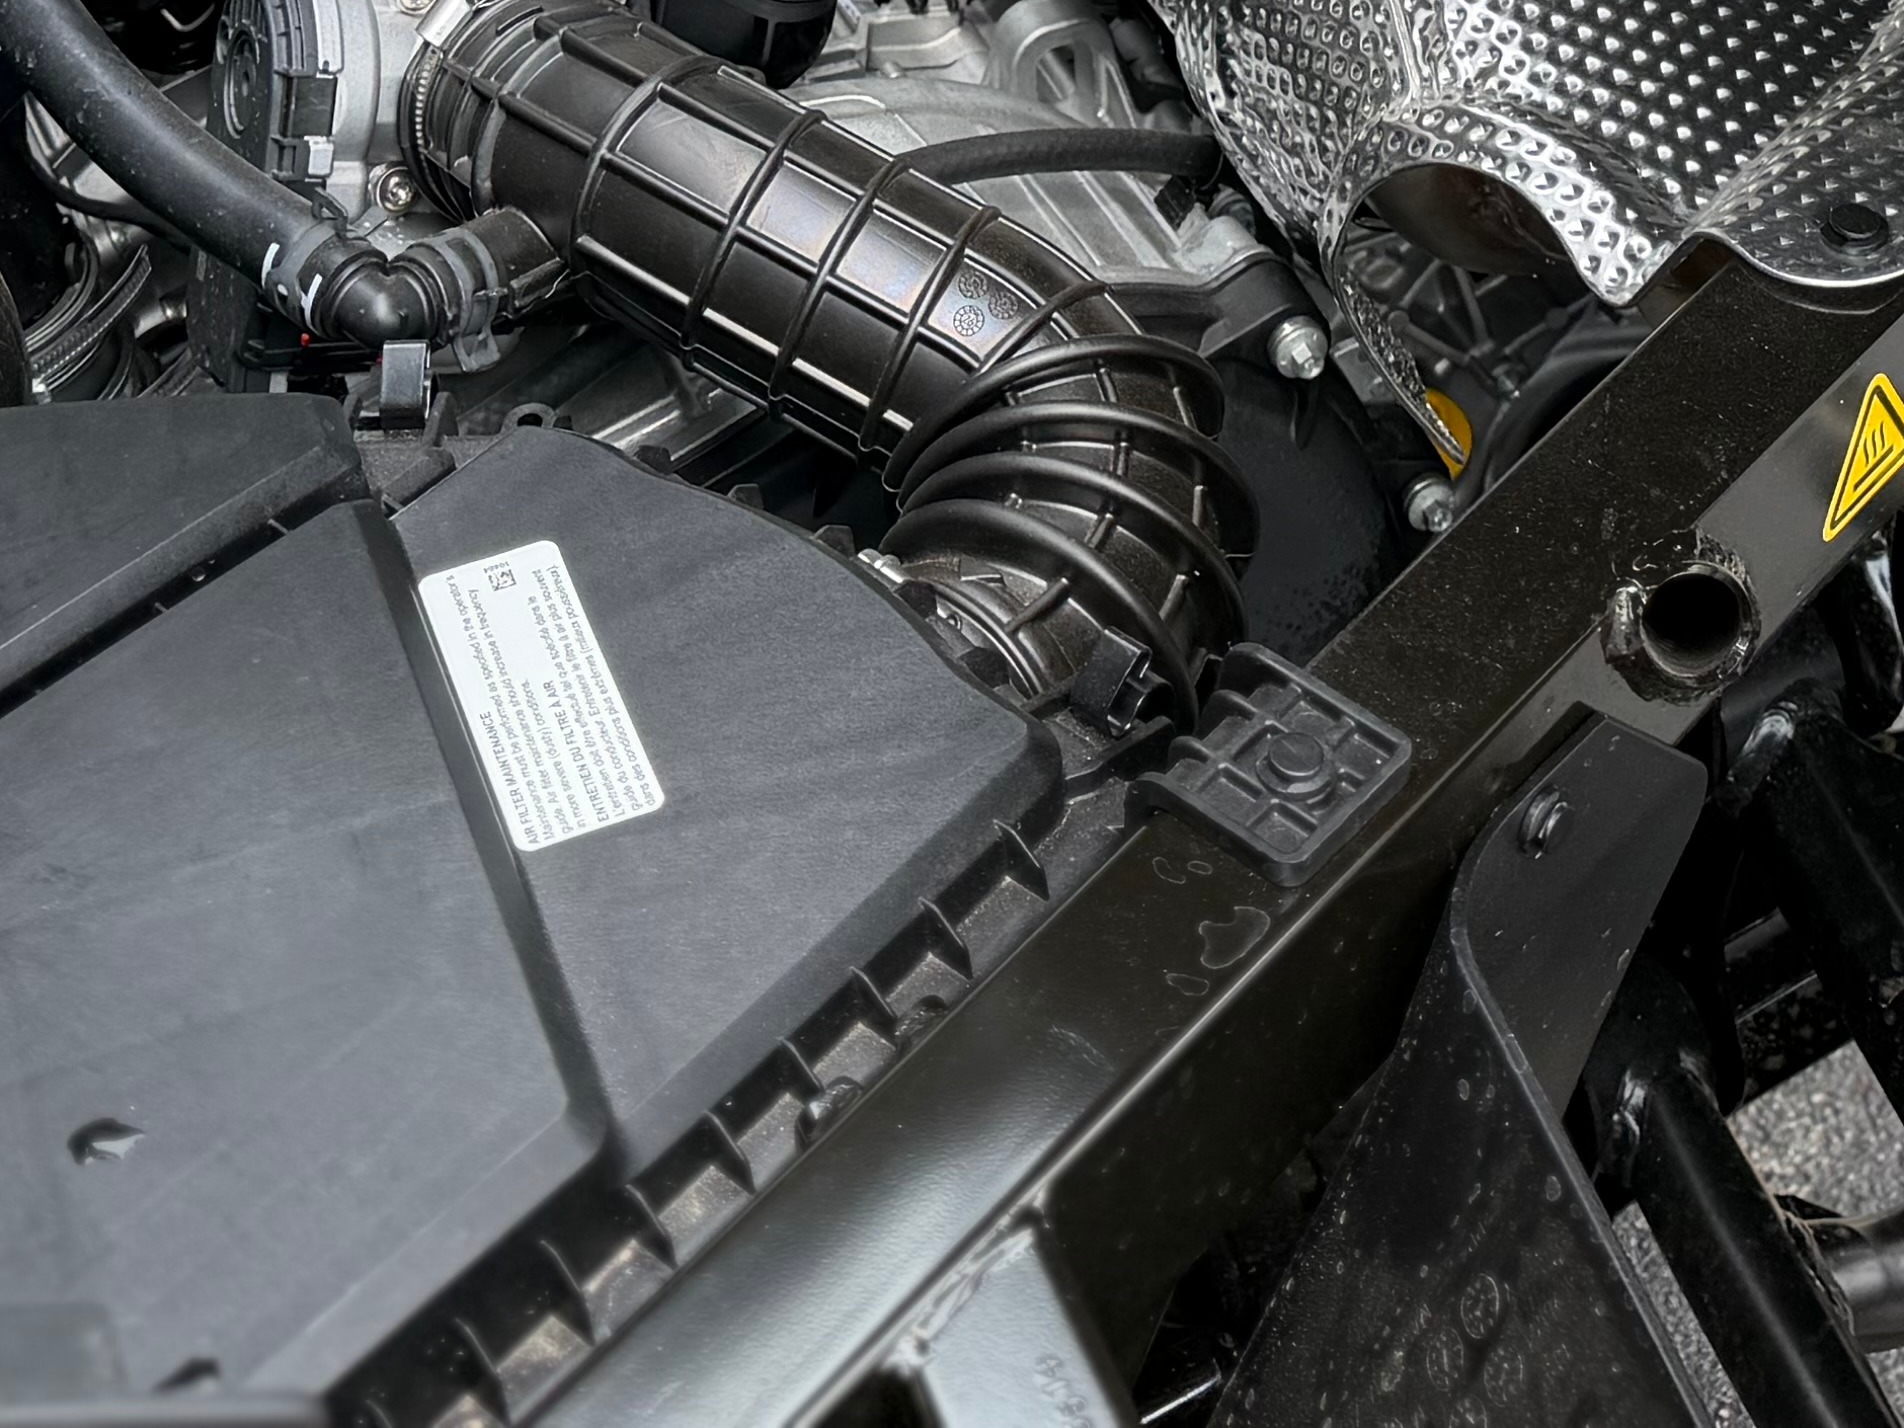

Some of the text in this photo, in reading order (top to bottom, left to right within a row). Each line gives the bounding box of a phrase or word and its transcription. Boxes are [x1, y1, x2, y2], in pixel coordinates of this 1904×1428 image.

[531, 568, 553, 602] souvent
[467, 588, 490, 631] frequency
[526, 595, 538, 606] le
[546, 602, 563, 622] plus
[530, 604, 547, 626] dans
[482, 629, 495, 641] in
[552, 622, 567, 634] air
[570, 619, 594, 654] (milieux
[537, 627, 561, 661] spécifié
[562, 641, 578, 663] filtre
[487, 639, 509, 678] increase
[553, 660, 568, 679] que
[570, 662, 582, 673] le
[558, 679, 573, 693] tel
[584, 653, 609, 695] extrêmes
[499, 677, 522, 708] should
[574, 673, 601, 717] Entretenir
[445, 574, 556, 841] Maintenance must be performed as specified in the operator's
[564, 692, 589, 729] effectué
[601, 695, 620, 716] plus
[514, 708, 544, 767] maintenance
[582, 728, 597, 748] être
[611, 716, 638, 763] conditions
[520, 678, 587, 829] in more severe (dusty) conditions.
[542, 679, 610, 823] ENTRETIEN DU FILTRE À AIR
[588, 748, 605, 768] doit
[479, 711, 541, 845] AIR FILTER MAINTENANCE
[537, 768, 553, 790] filter
[616, 769, 630, 784] du
[630, 762, 646, 782] des
[545, 790, 560, 804] Air
[622, 784, 644, 811] guide
[639, 782, 656, 807] dans
